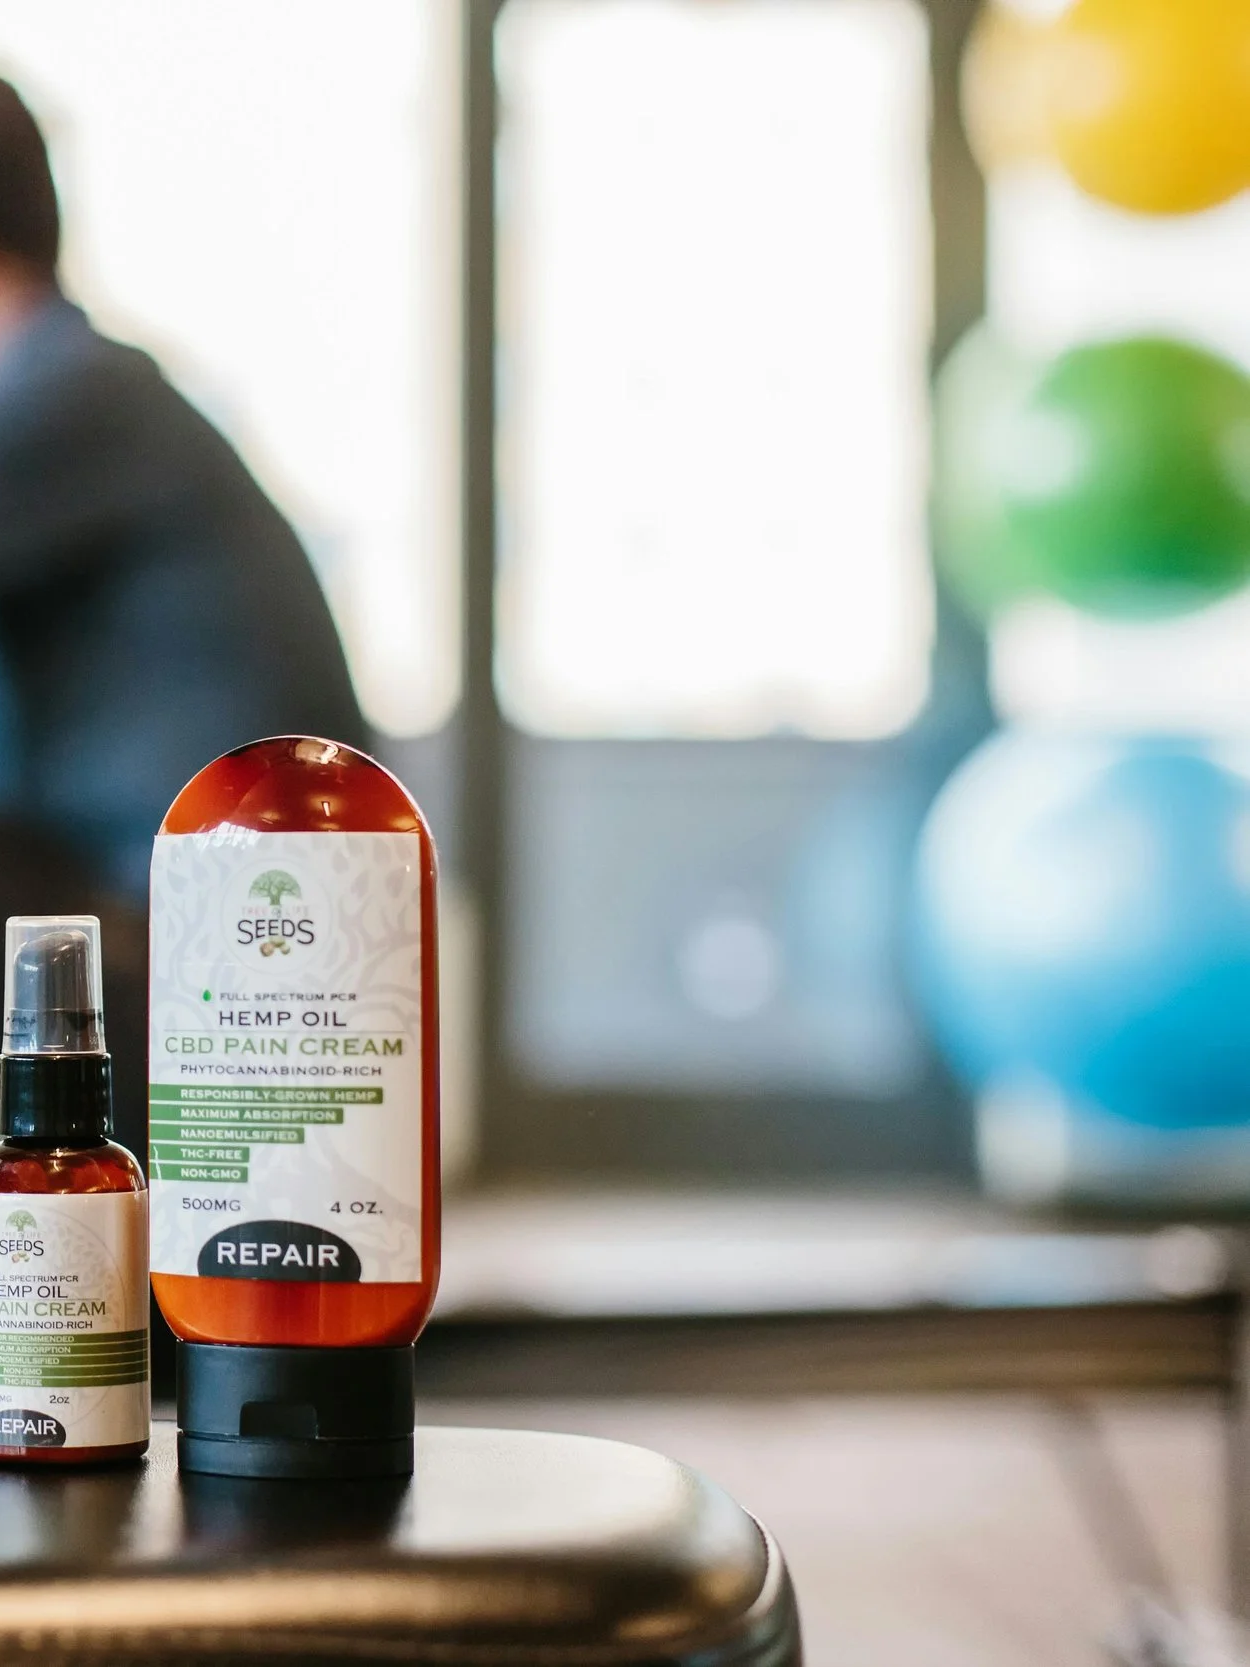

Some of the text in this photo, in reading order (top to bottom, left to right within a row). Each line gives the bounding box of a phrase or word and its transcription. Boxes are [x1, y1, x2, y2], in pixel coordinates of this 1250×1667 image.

[237, 919, 315, 945] SEEDS
[220, 993, 357, 1001] FULL SPECTRUM PCR
[219, 1011, 347, 1027] HEMP OIL
[165, 1037, 403, 1056] CBD PAIN CREAM
[181, 1065, 382, 1076] PHYTOCANNABINOID-RICH
[181, 1089, 376, 1101] RESPONSIBLY-GROWN HEMP
[181, 1109, 335, 1121] MAXIMUM ABSORPTION
[181, 1129, 297, 1140] NANOEMULSIFIED
[181, 1149, 242, 1160] THC-FREE
[181, 1168, 241, 1179] NON-GMO
[182, 1197, 383, 1214] 500MG 4 OZ.
[0, 1240, 44, 1256] SEEDS
[217, 1242, 339, 1266] REPAIR
[37, 1286, 68, 1298] OIL
[34, 1301, 106, 1316] CREAM
[9, 1334, 74, 1342] RECOMMENDED
